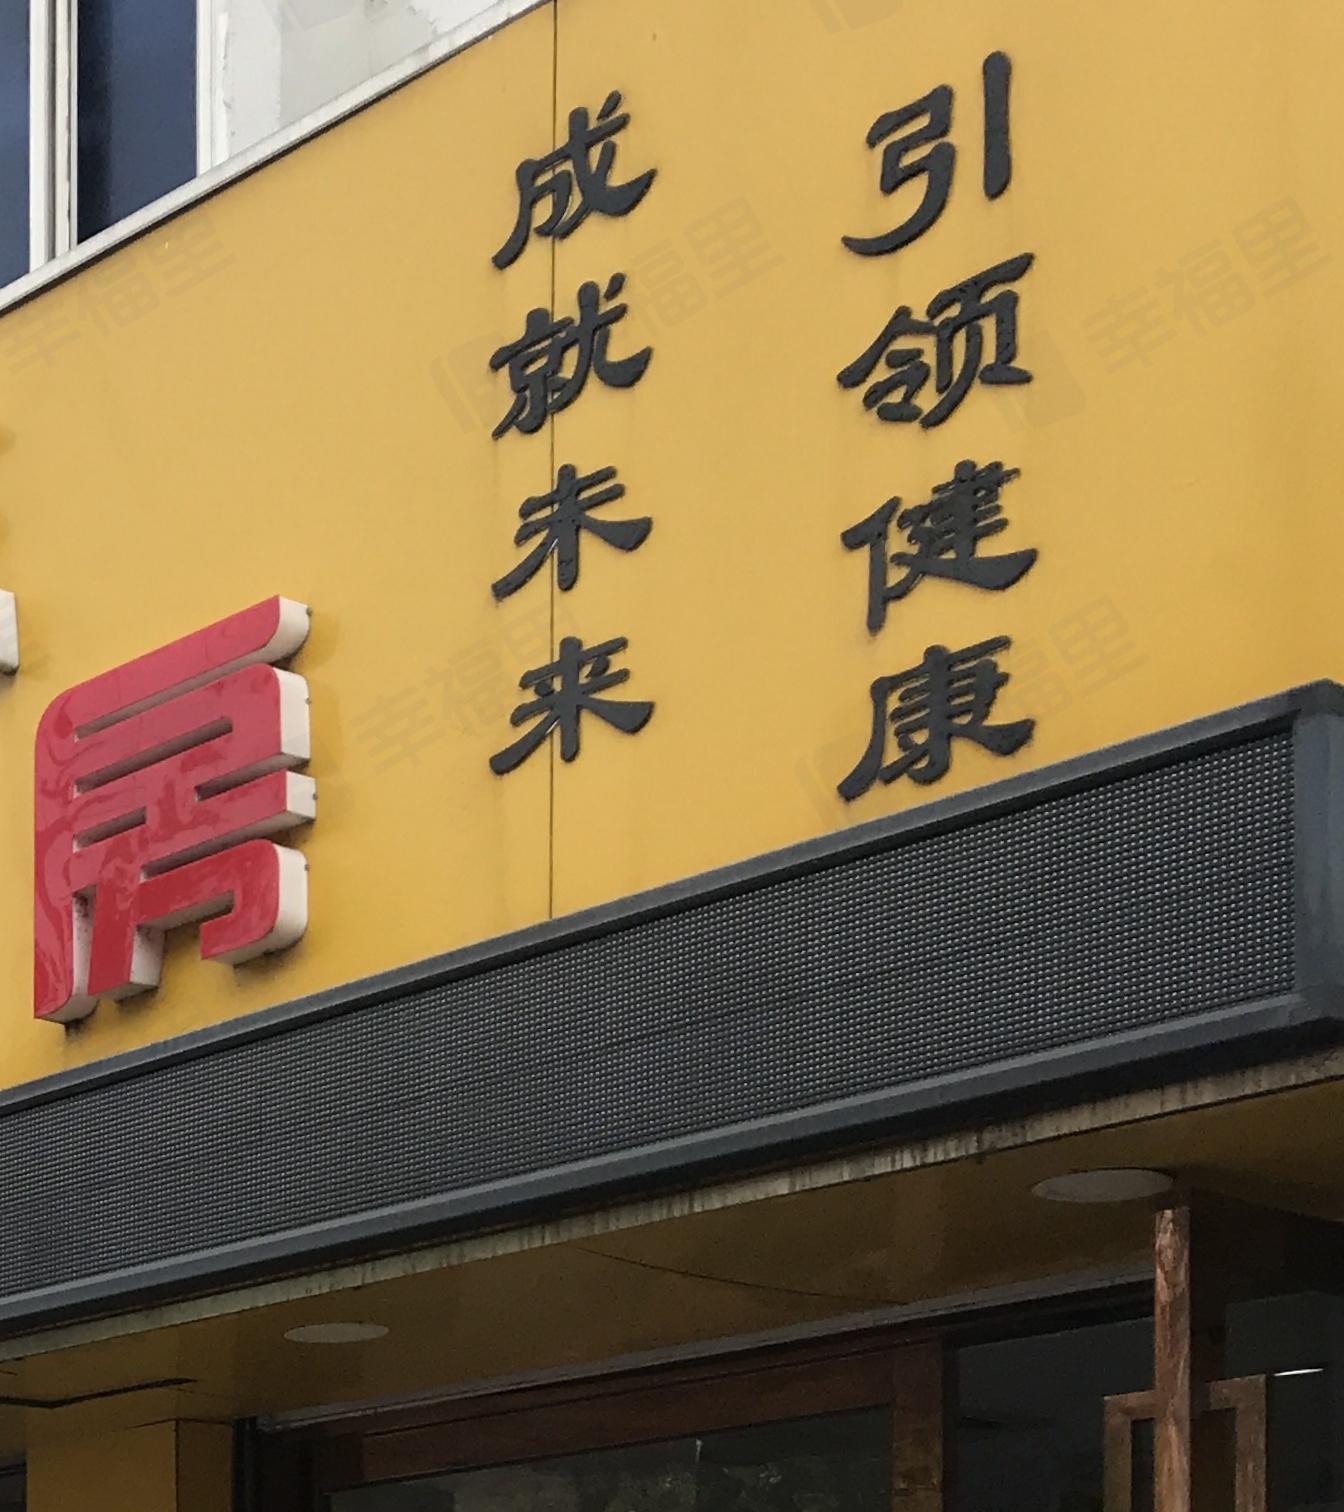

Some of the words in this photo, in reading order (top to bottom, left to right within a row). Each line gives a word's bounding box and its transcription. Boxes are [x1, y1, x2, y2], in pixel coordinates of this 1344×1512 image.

[489, 91, 657, 777] 成就未来
[838, 52, 1038, 801] 引领健康
